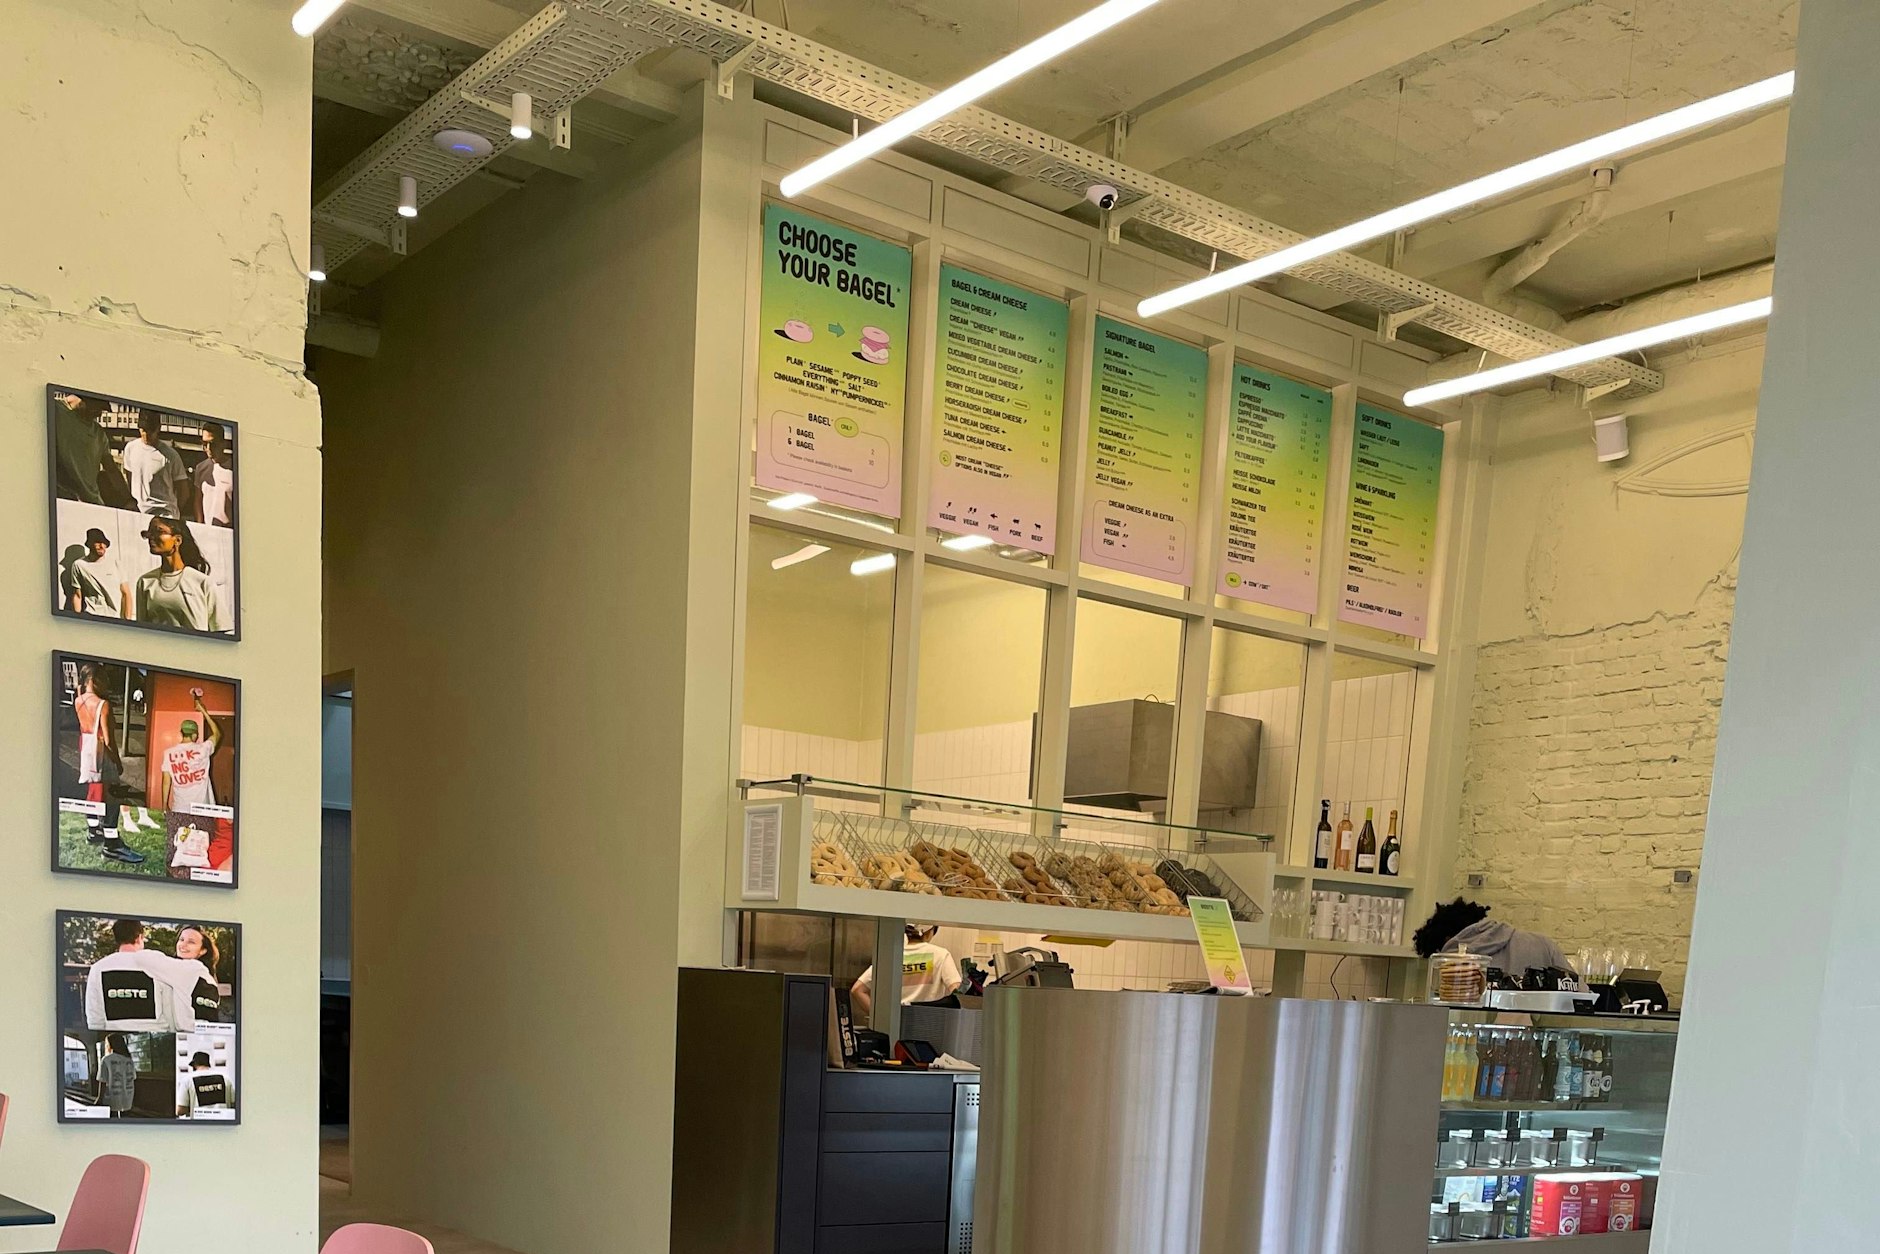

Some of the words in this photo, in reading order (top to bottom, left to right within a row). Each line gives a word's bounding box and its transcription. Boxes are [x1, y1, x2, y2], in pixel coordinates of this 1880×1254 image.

[778, 219, 857, 267] CHOOSE
[777, 249, 830, 287] YOUR
[951, 278, 972, 293] BAGEL
[978, 287, 1000, 302] CREAM
[1002, 295, 1027, 311] CHEESE
[950, 297, 969, 309] CREAM
[970, 303, 991, 317] CHEESE
[949, 314, 968, 326] CREAM
[998, 329, 1016, 340] VEGAN
[948, 330, 965, 341] MIXED
[966, 336, 996, 351] VEGETABLE
[997, 345, 1016, 357] CREAM
[1016, 351, 1037, 364] CHEESE
[1104, 329, 1137, 348] SIGNATURE
[1137, 340, 1156, 354] BAGEL
[947, 346, 977, 362] CUCUMBER
[977, 356, 996, 368] CREAM
[997, 362, 1018, 374] CHEESE
[1103, 346, 1123, 359] SALMON
[773, 371, 805, 386] CINNAMON
[842, 371, 861, 383] POPPY
[946, 363, 977, 378] CHOCOLATE
[978, 372, 996, 384] CREAM
[997, 378, 1018, 391] CHEESE
[945, 379, 963, 391] BERRY
[964, 385, 983, 396] CREAM
[984, 391, 1005, 403] CHEESE
[943, 412, 958, 422] TUNA
[959, 416, 978, 428] CREAM
[979, 421, 1000, 434] CHEESE
[982, 406, 1000, 418] CREAM
[1001, 412, 1022, 424] CHEESE
[796, 427, 815, 440] BAGEL
[942, 428, 964, 440] SALMON
[965, 434, 984, 446] CREAM
[985, 440, 1006, 451] CHEESE
[795, 439, 814, 451] BAGEL
[1110, 476, 1126, 486] VEGAN
[1108, 499, 1125, 510] CREAM
[1125, 504, 1144, 515] CHEESE
[1158, 512, 1174, 522] EXTRA
[1102, 537, 1114, 546] FISH
[1103, 527, 1119, 537] VEGAN
[171, 761, 189, 774] ING
[174, 769, 205, 785] LOVE?
[108, 989, 147, 998] BESTE
[840, 1016, 854, 1057] BESTE
